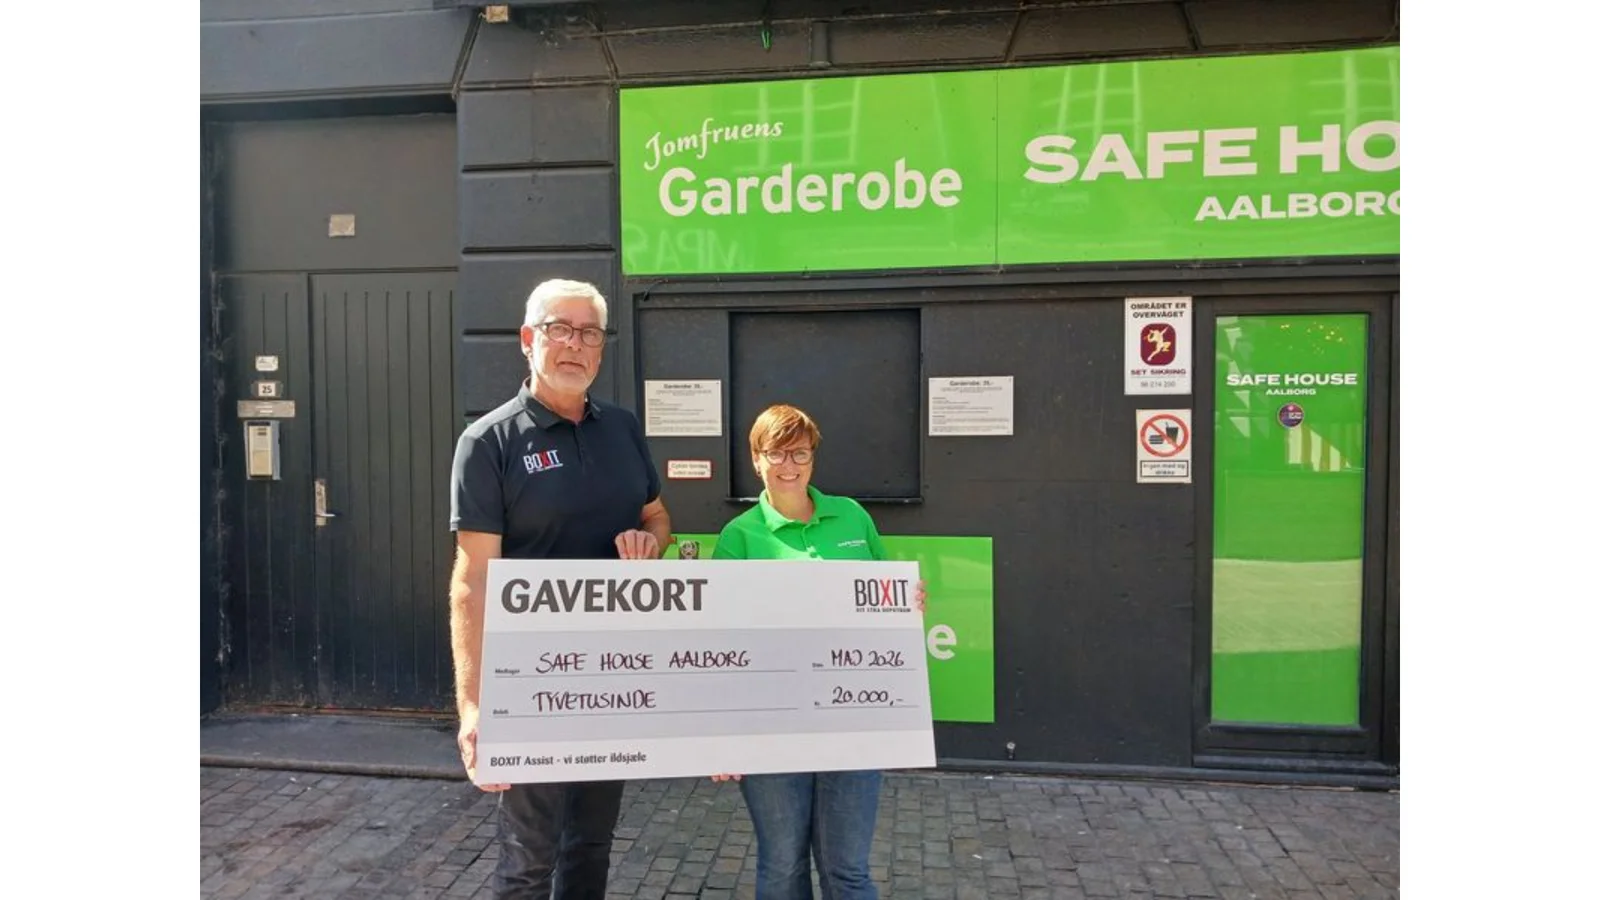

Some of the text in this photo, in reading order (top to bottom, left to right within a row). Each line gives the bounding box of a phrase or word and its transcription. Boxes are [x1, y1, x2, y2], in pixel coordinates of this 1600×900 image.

[643, 117, 784, 171] Jomfruens
[1023, 127, 1257, 184] SAFE
[658, 157, 963, 217] Garderobe
[1130, 302, 1173, 310] OMRÅDET
[1132, 310, 1184, 319] OVERVÅGET
[262, 385, 272, 394] 25
[1226, 373, 1358, 386] SAFE HOUSE
[1265, 388, 1317, 396] AALBORG
[522, 449, 560, 472] BOXIT
[501, 578, 709, 614] GAVEKORT
[854, 579, 909, 607] BOXIT
[535, 650, 751, 674] SAFE HOUSE AALBORG
[868, 650, 904, 667] 2026
[532, 689, 657, 713] TYVETUSINDE
[832, 686, 904, 706] 20.000,-
[490, 756, 521, 767] BOXIT
[524, 756, 554, 766] Assist
[564, 755, 573, 764] vi
[575, 754, 607, 765] støtter
[610, 752, 647, 765] ildsjæle
